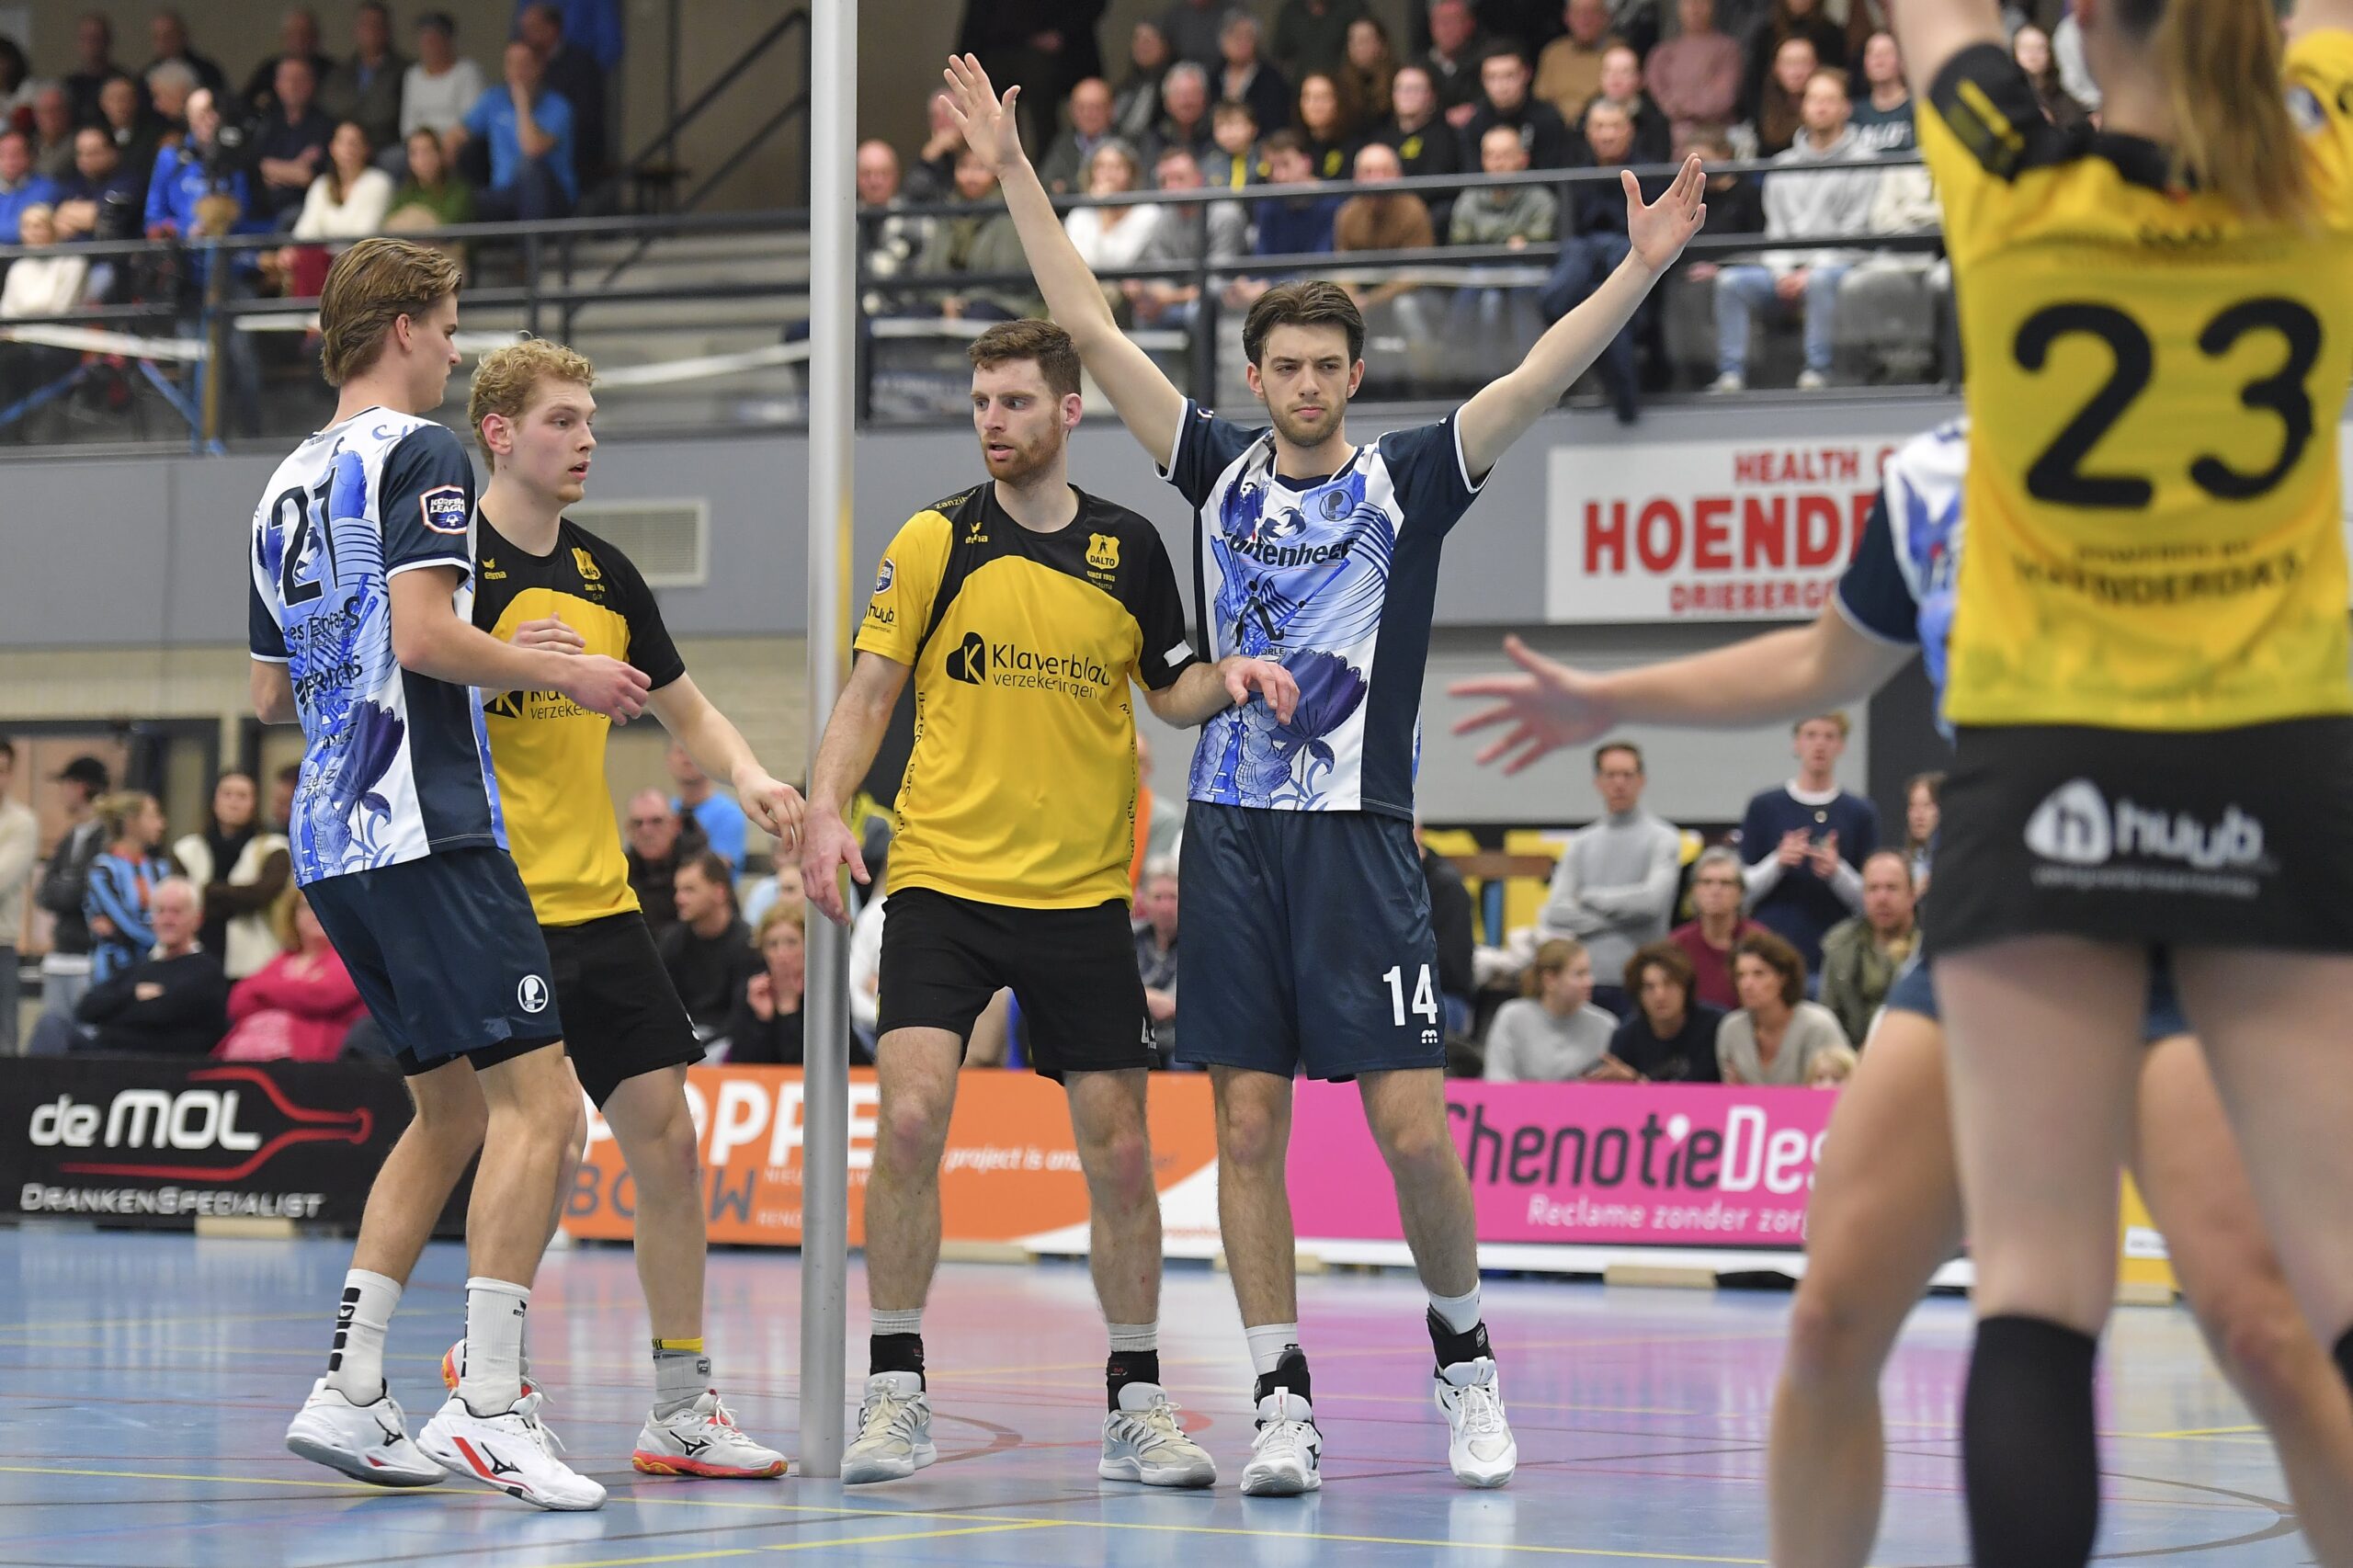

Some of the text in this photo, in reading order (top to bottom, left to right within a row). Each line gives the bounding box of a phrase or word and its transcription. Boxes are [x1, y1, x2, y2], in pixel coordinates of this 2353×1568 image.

[2013, 296, 2324, 511] 23
[1734, 449, 1859, 483] HEALTH
[429, 504, 467, 515] LEAGU
[430, 498, 466, 507] KORFBA
[270, 465, 339, 608] 21
[1090, 554, 1116, 567] DALTO
[2116, 798, 2265, 869] huub
[1382, 963, 1438, 1026] 14
[28, 1088, 262, 1151] de MOL
[945, 1145, 1083, 1174] project is onz
[1528, 1194, 1644, 1228] Reclame
[1653, 1199, 1750, 1232] zonder
